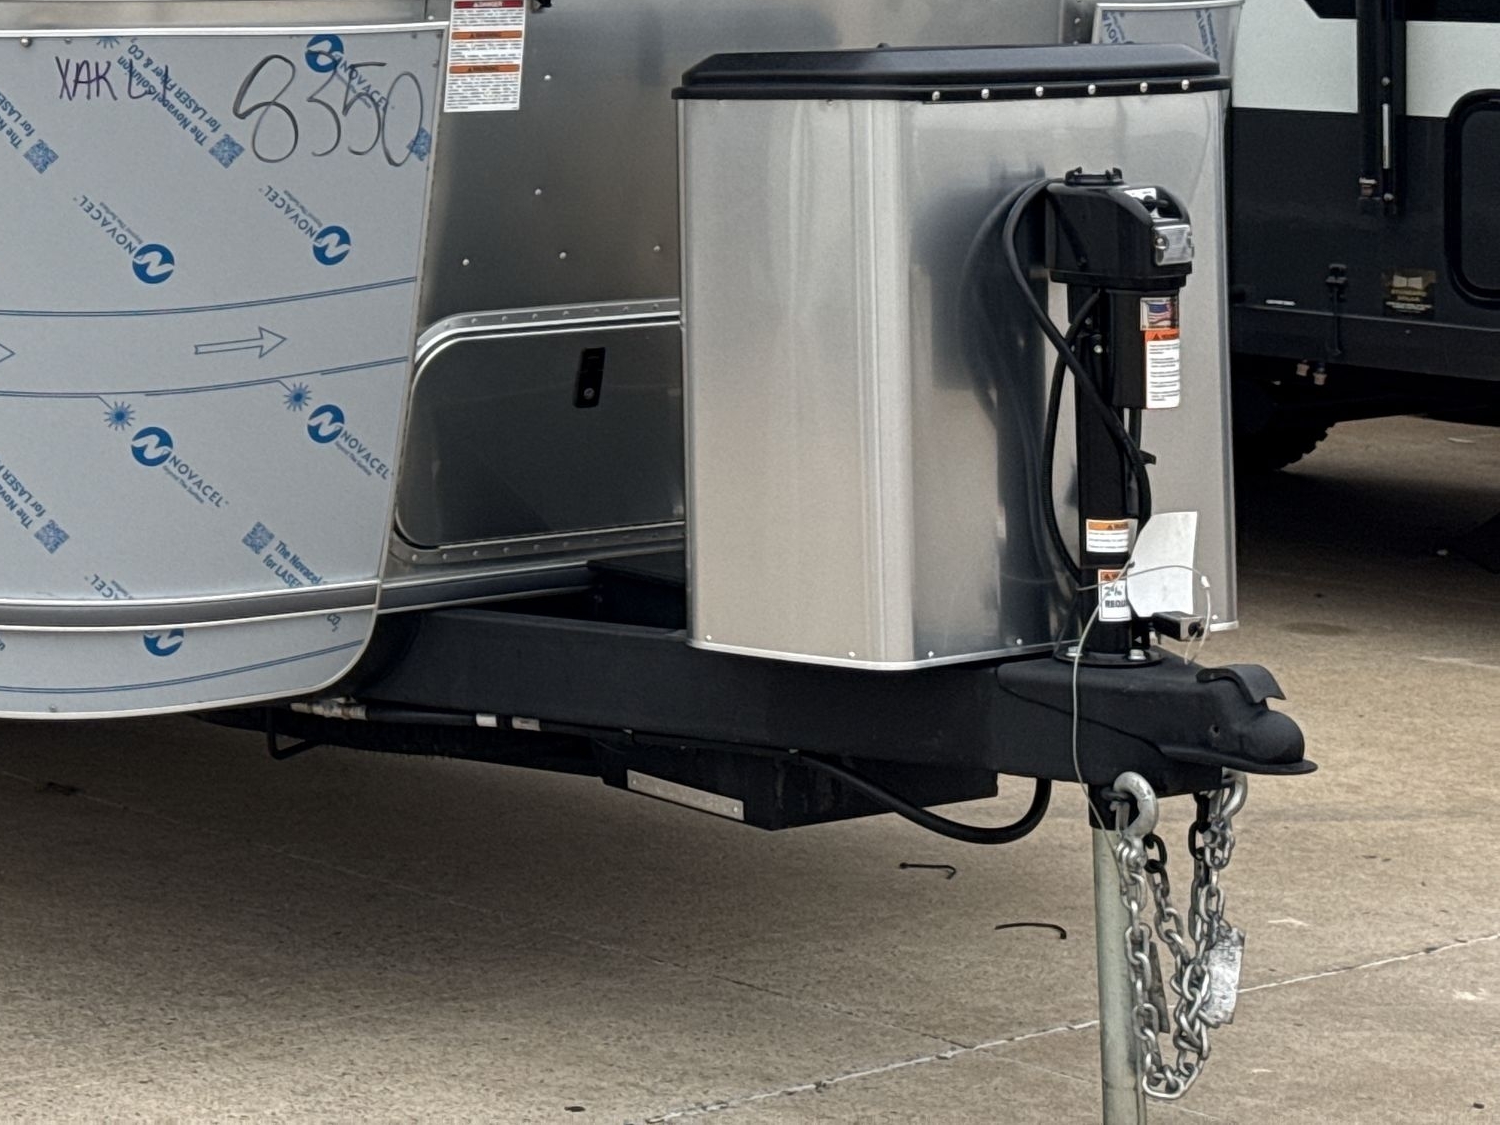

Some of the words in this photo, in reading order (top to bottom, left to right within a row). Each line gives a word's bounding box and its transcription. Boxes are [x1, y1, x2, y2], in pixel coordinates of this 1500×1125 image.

[142, 56, 154, 69] &
[151, 91, 192, 131] Novacel
[173, 87, 208, 121] LASER
[233, 50, 423, 167] 8350
[6, 128, 23, 150] The
[20, 120, 36, 137] for
[188, 124, 208, 146] The
[204, 115, 222, 133] for
[78, 195, 136, 255] NOVACEL
[263, 185, 317, 240] NOVACEL
[339, 430, 388, 480] NOVACEL
[2, 469, 34, 503] LASER
[167, 454, 223, 508] NOVACEL
[16, 508, 33, 529] The
[30, 500, 46, 518] for
[262, 554, 277, 572] for
[275, 540, 291, 560] The
[289, 554, 323, 586] Novacel
